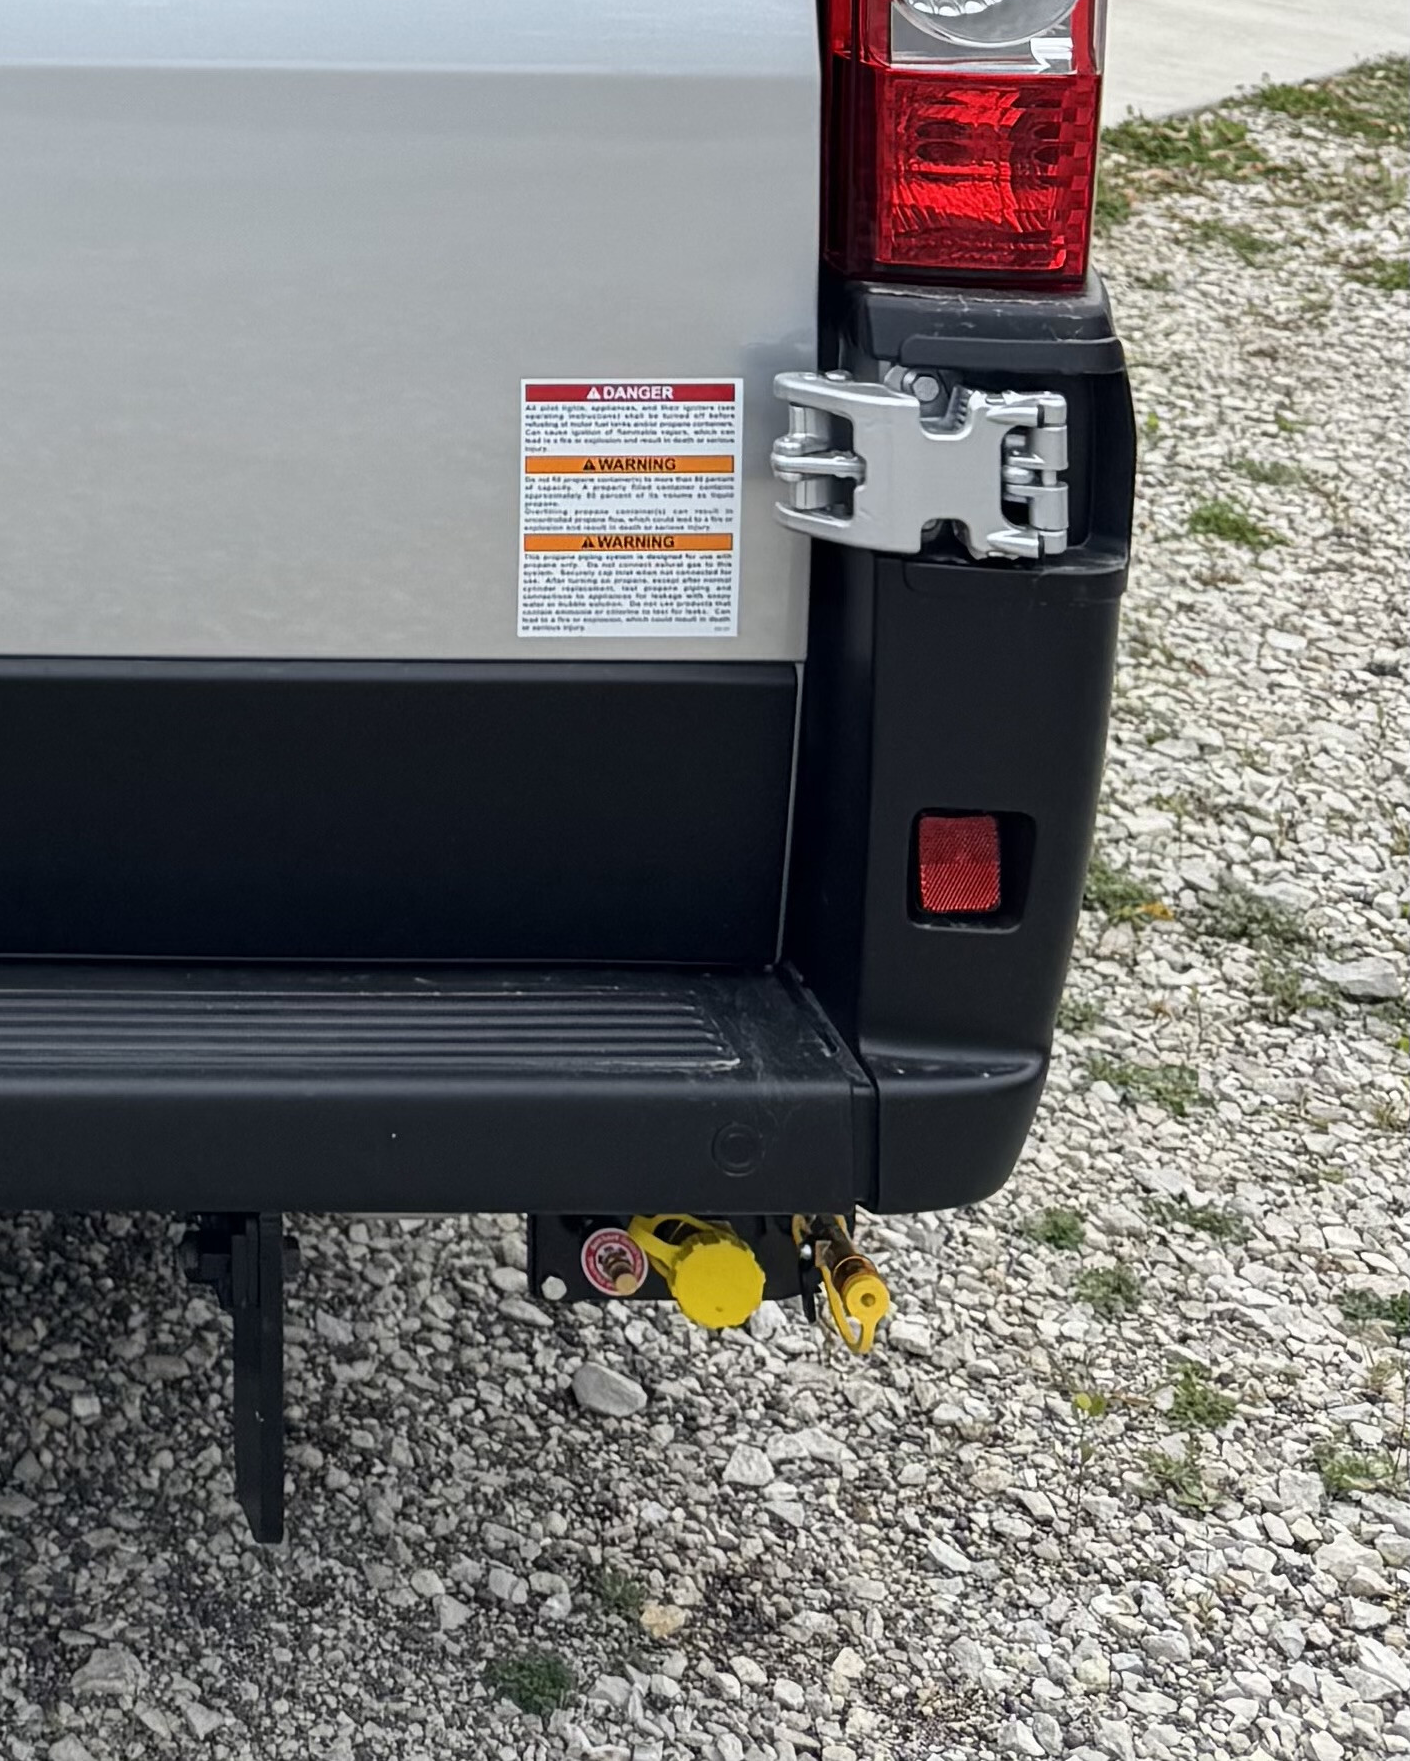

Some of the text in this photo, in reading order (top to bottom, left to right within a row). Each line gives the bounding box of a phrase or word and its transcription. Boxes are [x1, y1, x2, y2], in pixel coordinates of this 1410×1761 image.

[603, 386, 674, 400] DANGER
[598, 458, 676, 471] WARNING
[597, 535, 675, 549] WARNING
